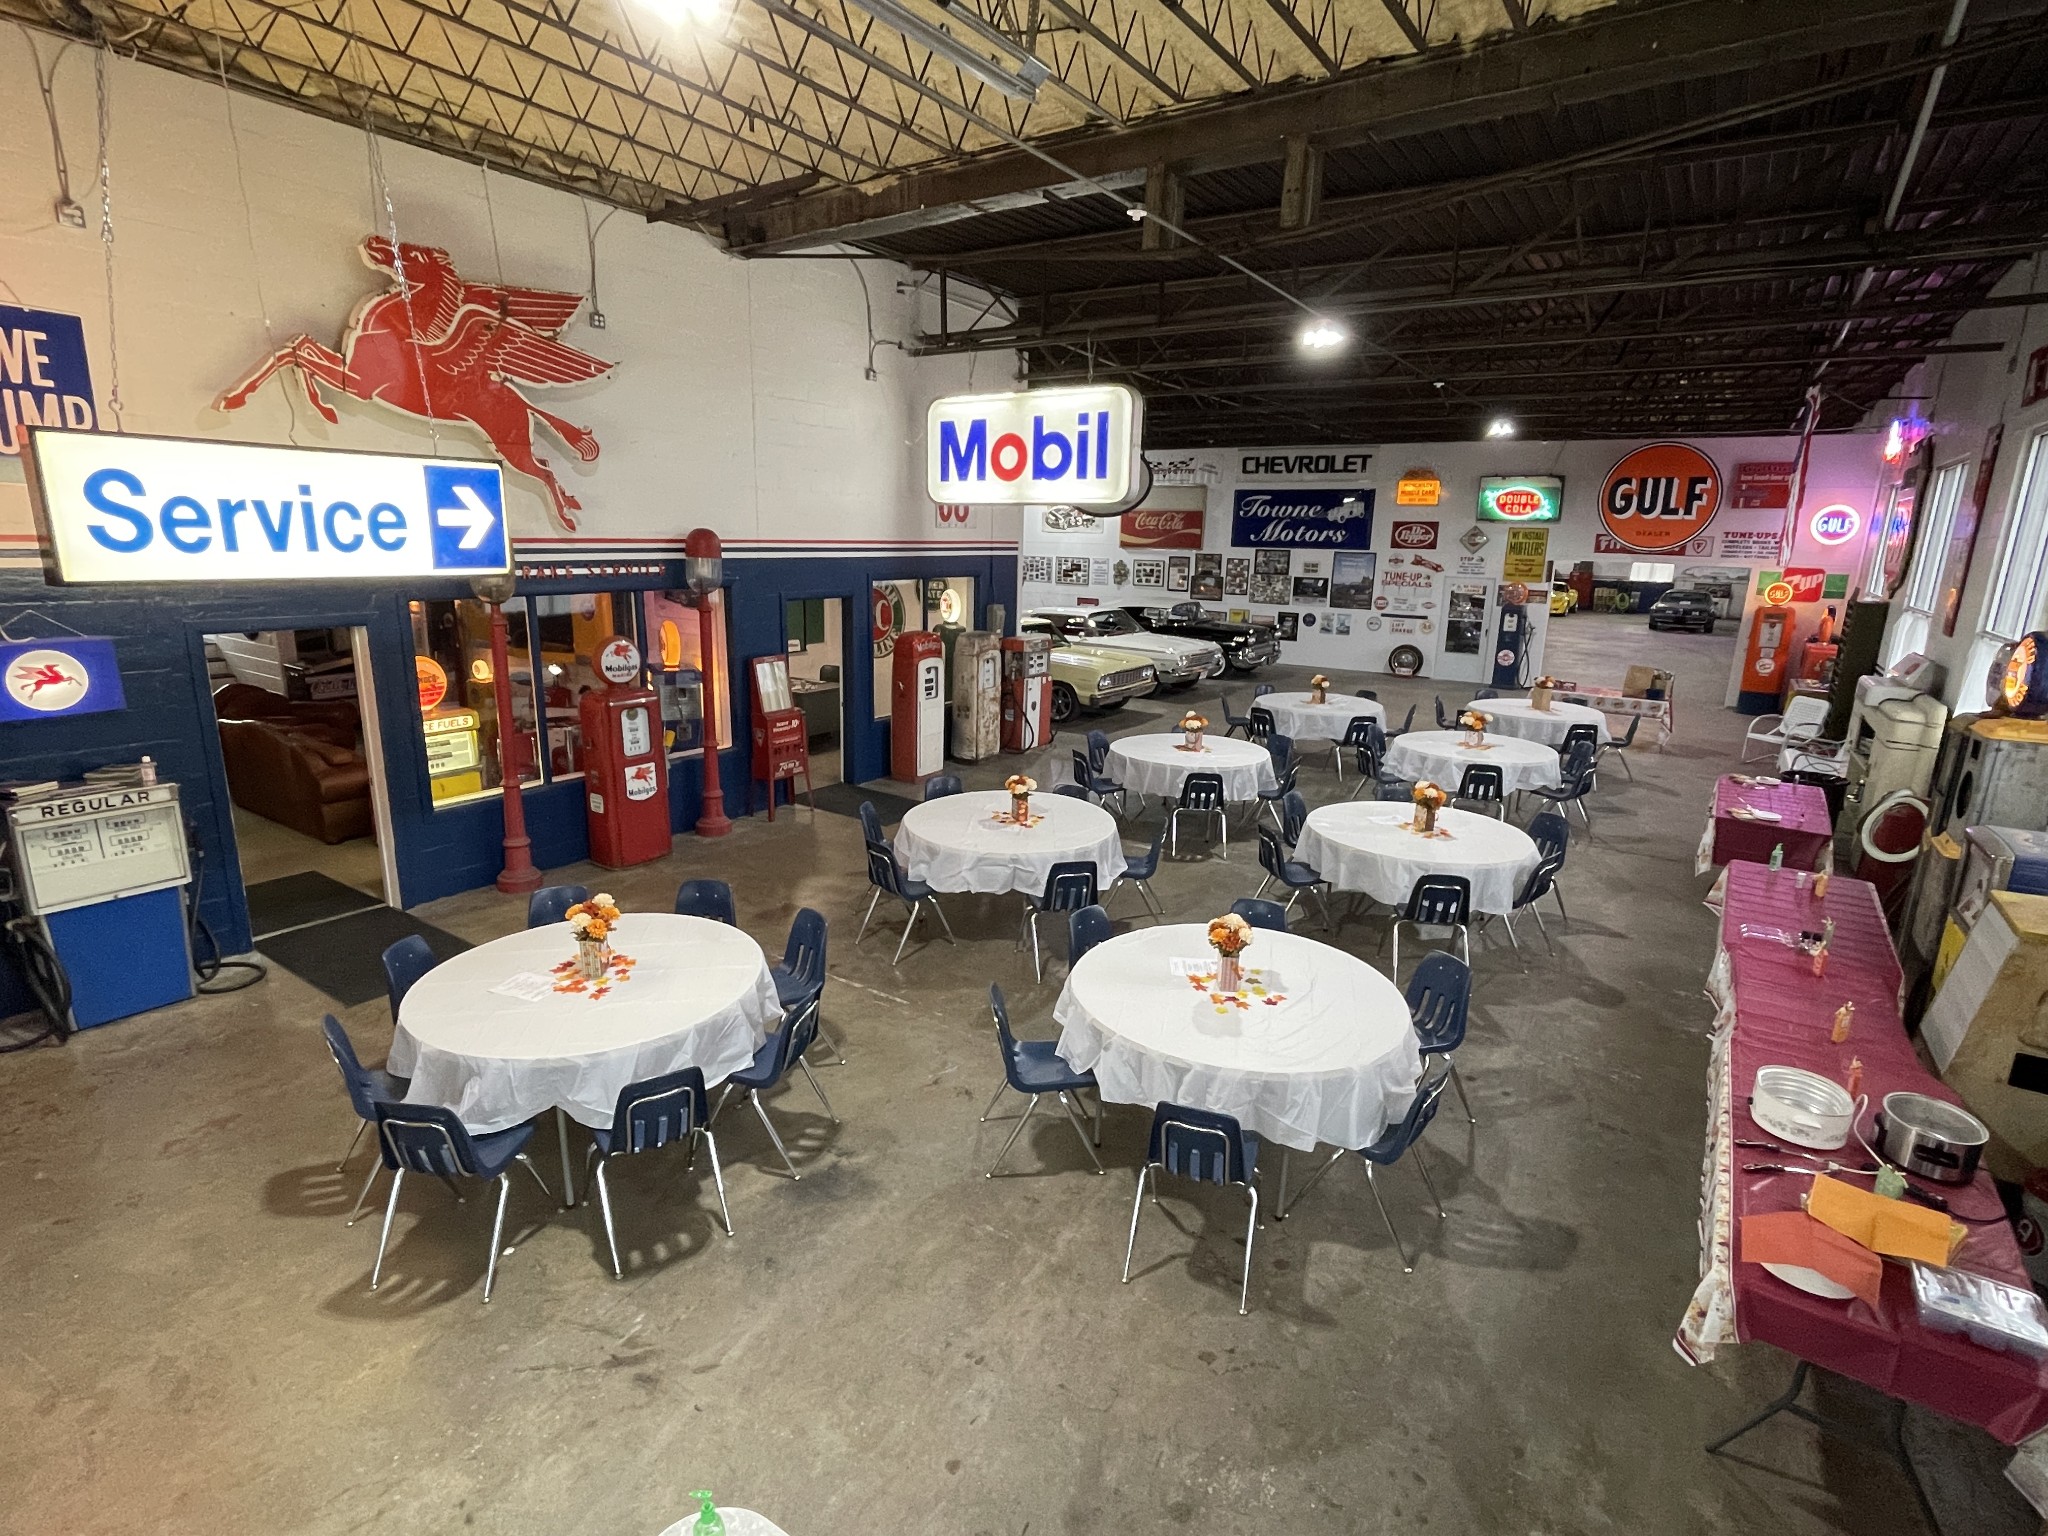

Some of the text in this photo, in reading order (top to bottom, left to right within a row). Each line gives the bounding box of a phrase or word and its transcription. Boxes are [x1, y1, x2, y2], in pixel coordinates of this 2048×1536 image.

[940, 411, 1109, 482] Mobil
[1241, 454, 1373, 474] CHEVROLET
[1499, 494, 1540, 505] DOUBLE
[1608, 476, 1712, 520] GULF
[83, 468, 407, 553] Service
[1239, 494, 1325, 518] Towne
[1505, 504, 1532, 514] COLA
[1249, 519, 1349, 543] Motors
[1411, 526, 1426, 536] Dr
[1816, 516, 1854, 535] GULF
[1400, 529, 1432, 544] Pepper
[1521, 531, 1546, 541] INSTALL
[1723, 531, 1778, 540] TUNE-UPS
[1508, 541, 1546, 556] MUFFLERS
[586, 563, 666, 577] SERVICE
[1384, 571, 1423, 581] TUNE-UP
[1381, 579, 1432, 588] SPECIALS
[605, 662, 638, 673] Mobilgas
[437, 717, 469, 730] FUELS
[628, 785, 657, 797] Mobilgas
[41, 791, 151, 818] REGULAR
